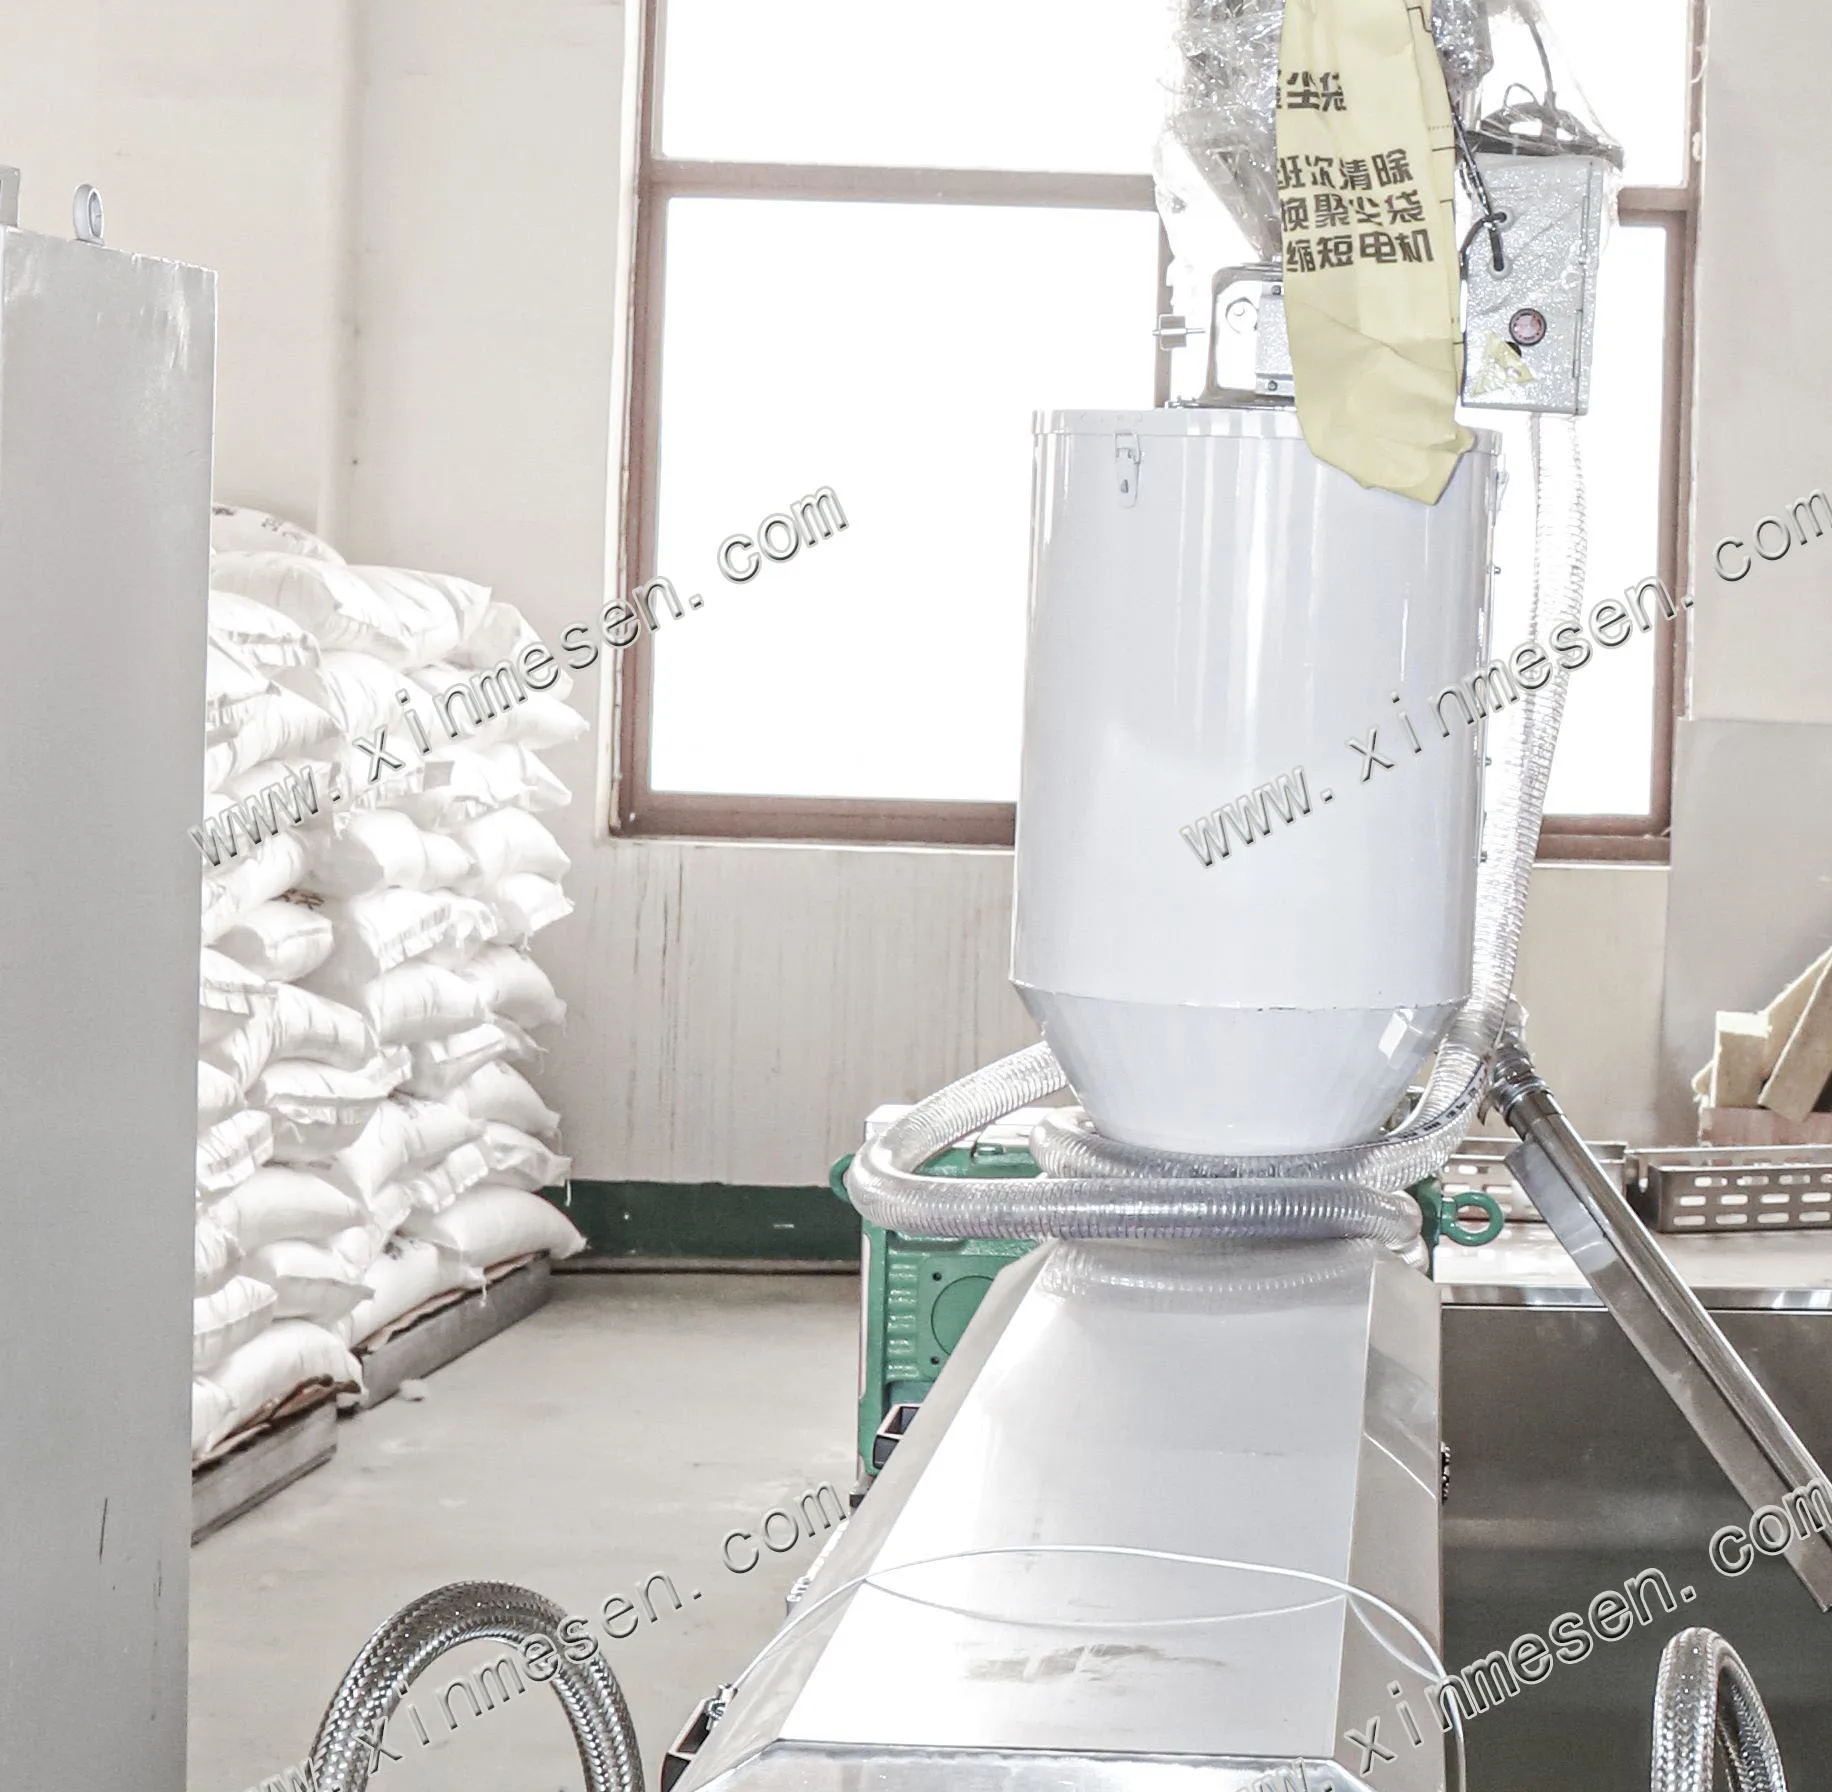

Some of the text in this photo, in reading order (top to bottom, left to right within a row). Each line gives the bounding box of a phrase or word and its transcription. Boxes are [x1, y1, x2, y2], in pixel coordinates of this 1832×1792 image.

[1277, 69, 1347, 112] 尘袋
[1286, 228, 1434, 272] 缩短电机
